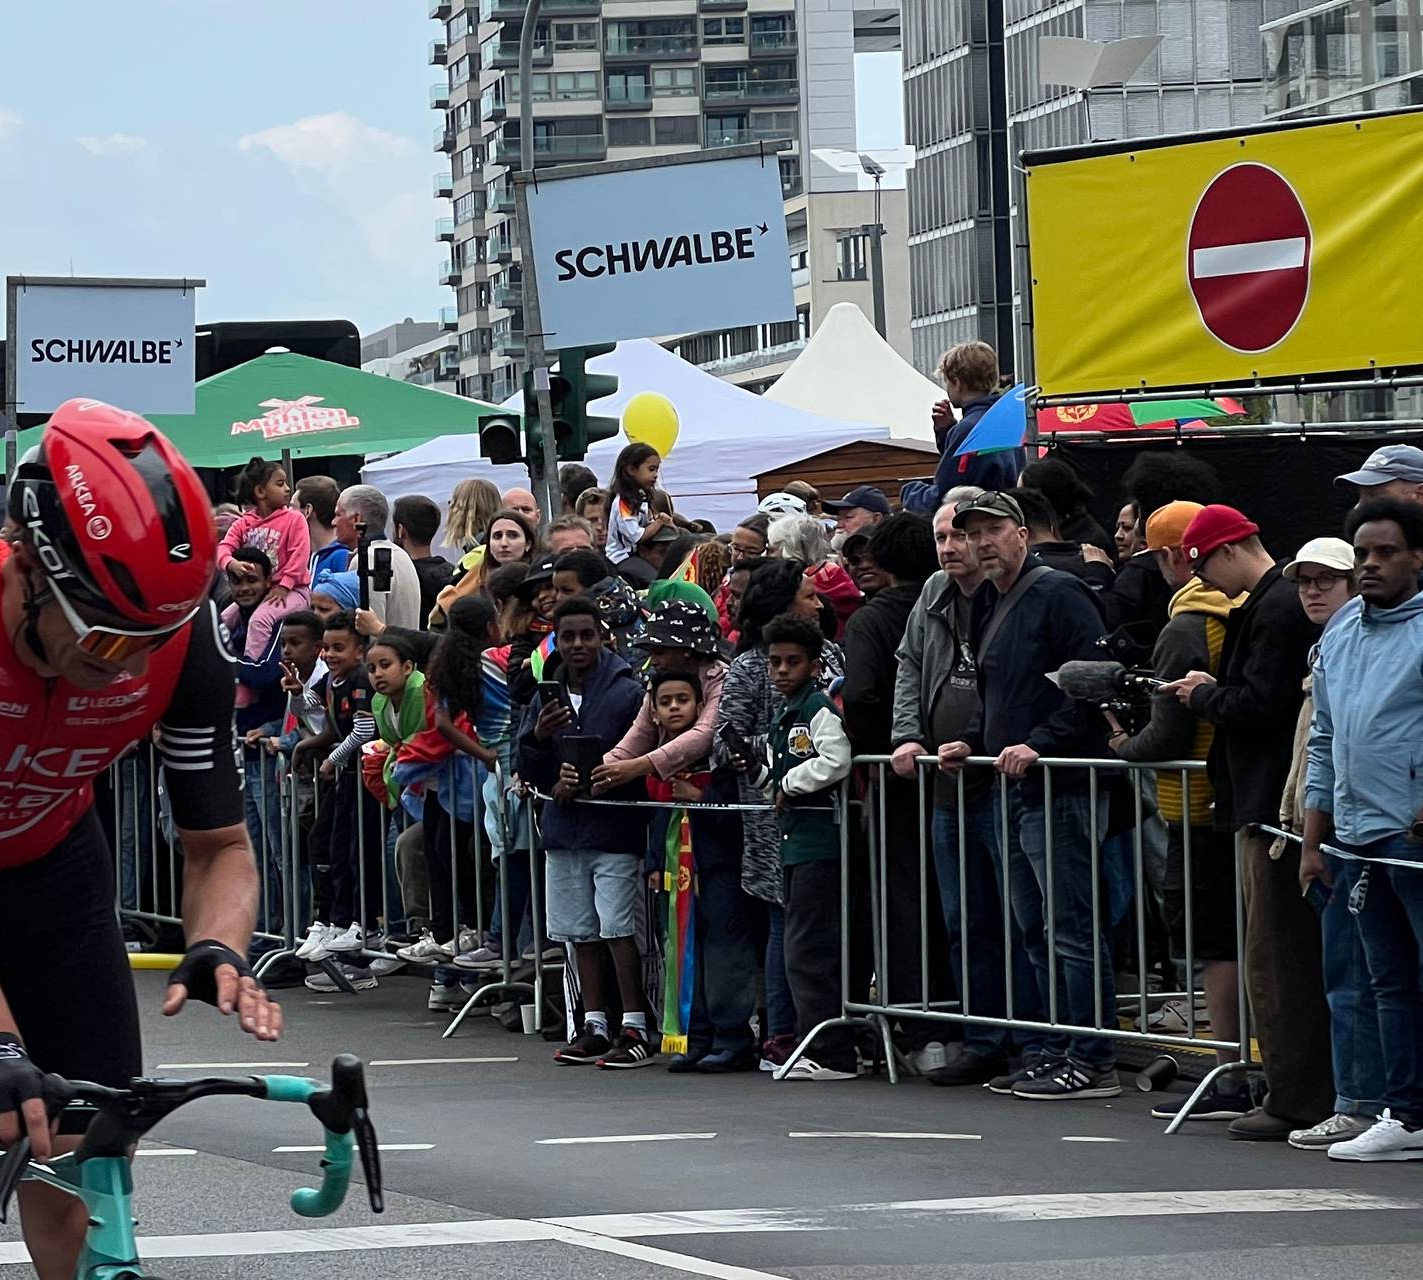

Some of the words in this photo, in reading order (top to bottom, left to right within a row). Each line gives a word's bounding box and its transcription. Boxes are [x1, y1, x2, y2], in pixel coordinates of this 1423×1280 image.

[555, 227, 755, 281] SCHWALBE
[31, 339, 172, 364] SCHWALBE
[65, 464, 97, 516] ARKEA
